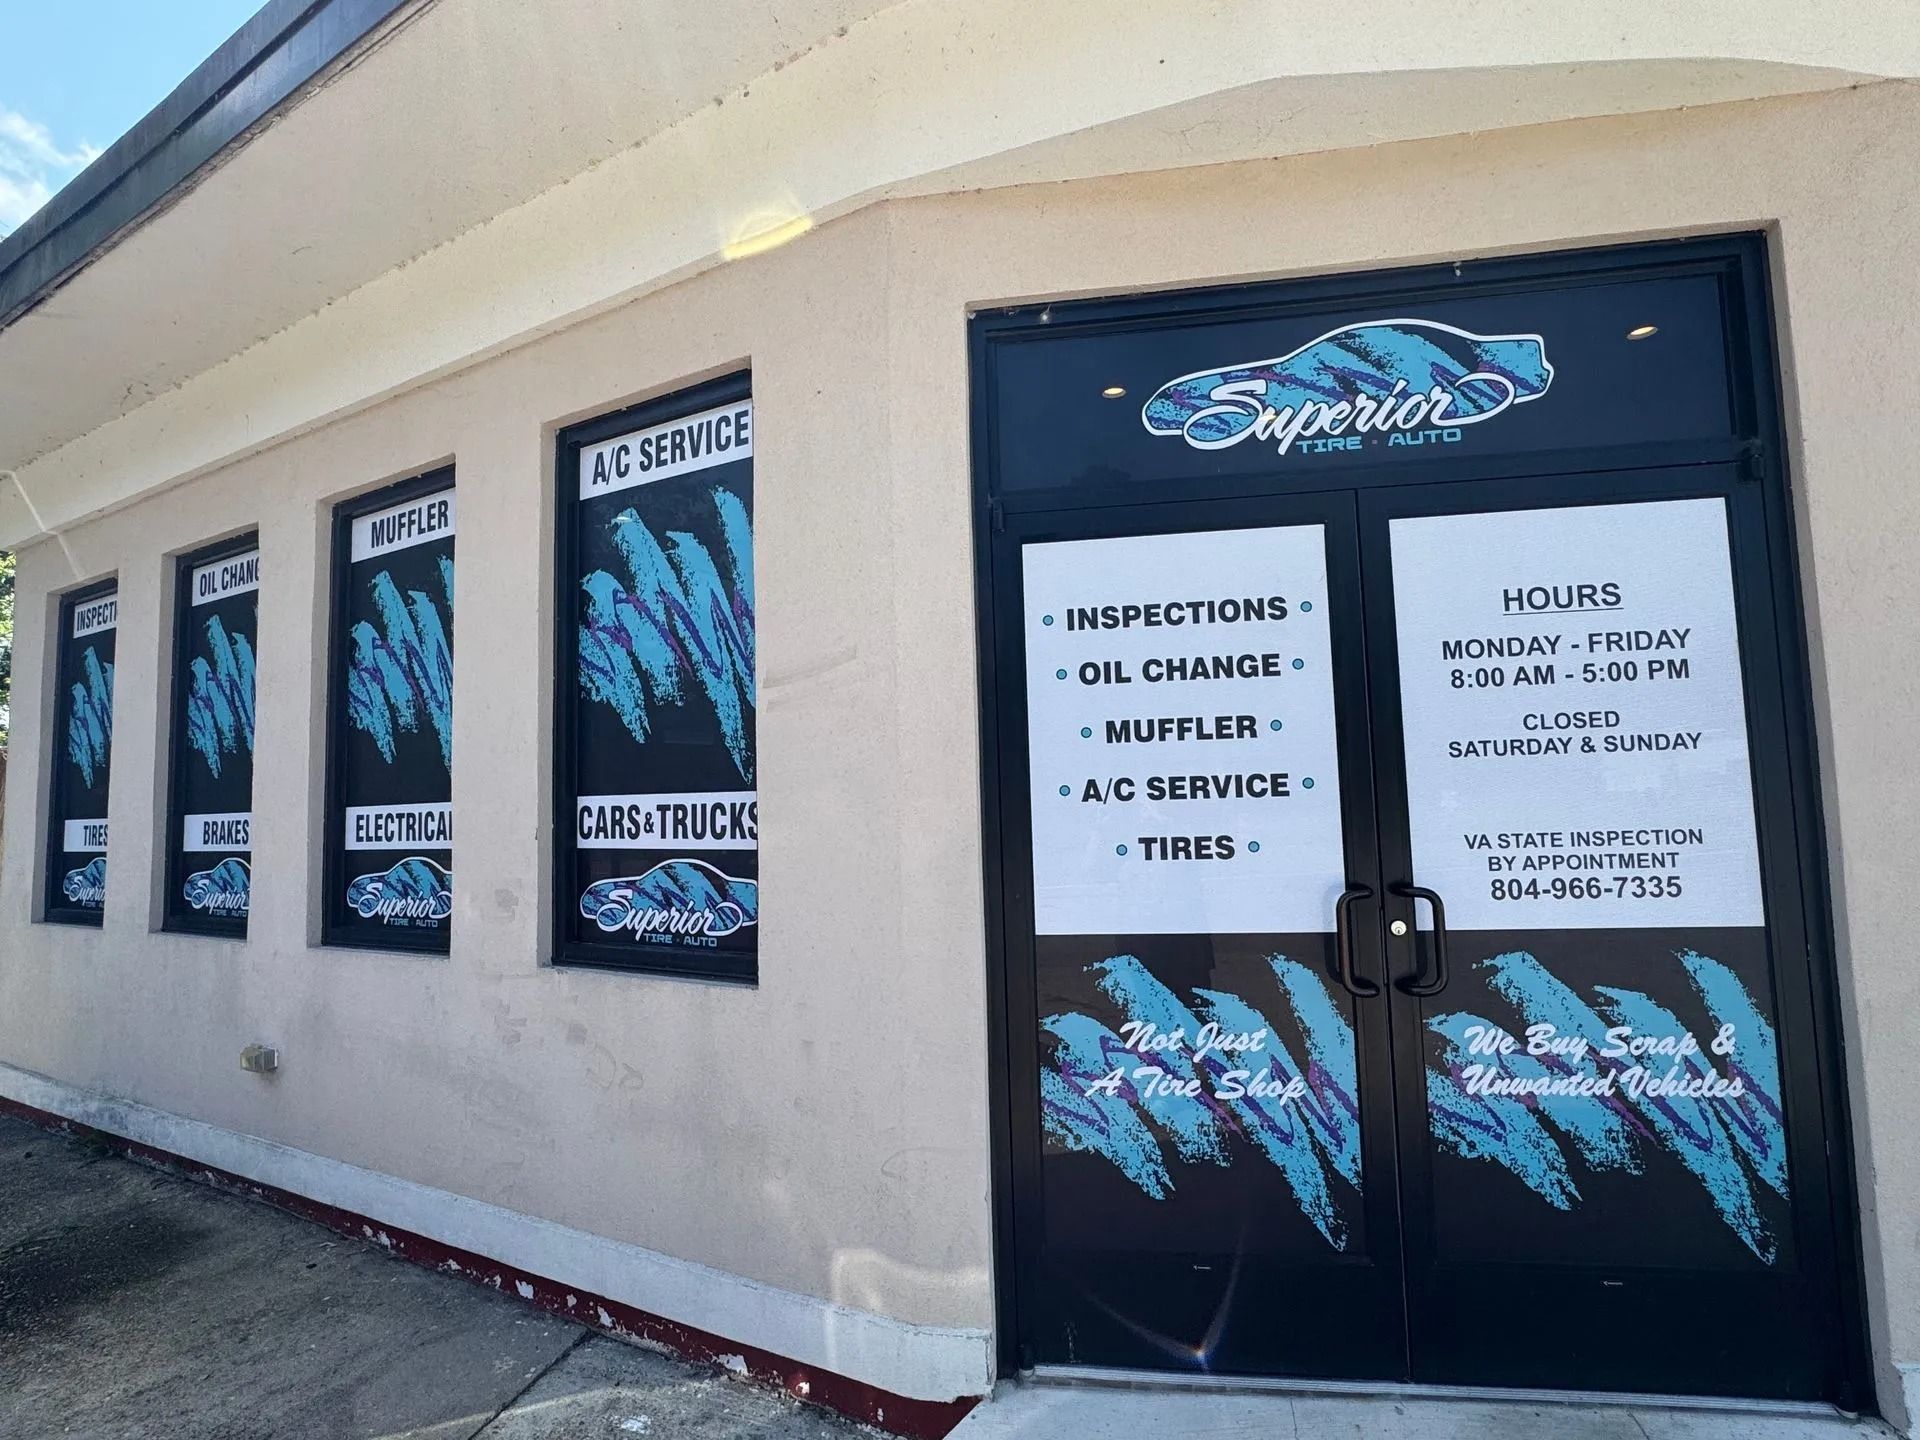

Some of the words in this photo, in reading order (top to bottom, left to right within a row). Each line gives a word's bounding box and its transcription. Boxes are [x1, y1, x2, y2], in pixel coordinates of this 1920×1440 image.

[1183, 371, 1515, 455] Superior
[592, 444, 631, 486] A/C
[639, 409, 750, 473] SERVICE
[1296, 437, 1363, 454] TIRE
[1387, 428, 1462, 447] AUTO
[371, 499, 449, 549] MUFFLER
[200, 570, 218, 597] OIL
[1502, 582, 1623, 613] HOURS
[1066, 596, 1288, 631] INSPECTIONS
[1441, 635, 1562, 660] MONDAY
[1587, 628, 1692, 653] FRIDAY
[1078, 661, 1132, 685] OIL
[1142, 653, 1282, 683] CHANGE
[1450, 667, 1505, 689] 8:00
[1512, 665, 1556, 686] AM
[1582, 660, 1639, 683] 5:00
[1647, 658, 1690, 680] PM
[1105, 715, 1258, 744] MUFFLER
[1522, 710, 1621, 731] CLOSED
[1448, 737, 1573, 758] SATURDAY
[1580, 736, 1597, 753] &
[1603, 732, 1702, 753] SUNDAY
[1081, 777, 1136, 804] A/C
[1146, 773, 1290, 801] SERVICE
[202, 819, 250, 845] BRAKES
[1464, 834, 1492, 850] VA
[1499, 832, 1563, 849] STATE
[1570, 829, 1703, 848] INSPECTION
[1138, 835, 1235, 861] TIRES
[1487, 857, 1516, 872] BY
[1522, 852, 1679, 871] APPOINTMENT
[358, 882, 452, 924] Superior
[1491, 876, 1683, 901] 804-966-7335
[596, 889, 743, 941] Superior
[643, 933, 673, 943] TIRE
[683, 936, 717, 947] AUTO
[1119, 1020, 1185, 1052] Not
[1193, 1021, 1268, 1063] Just
[1464, 1024, 1523, 1056] We
[1525, 1023, 1589, 1064] Buy
[1600, 1026, 1700, 1064] Scrap
[1711, 1022, 1736, 1055] &
[1084, 1067, 1125, 1097] A
[1132, 1066, 1202, 1098] Tire
[1214, 1067, 1307, 1106] Shop
[1461, 1063, 1617, 1098] Unwanted
[1619, 1065, 1746, 1098] Vehicles
